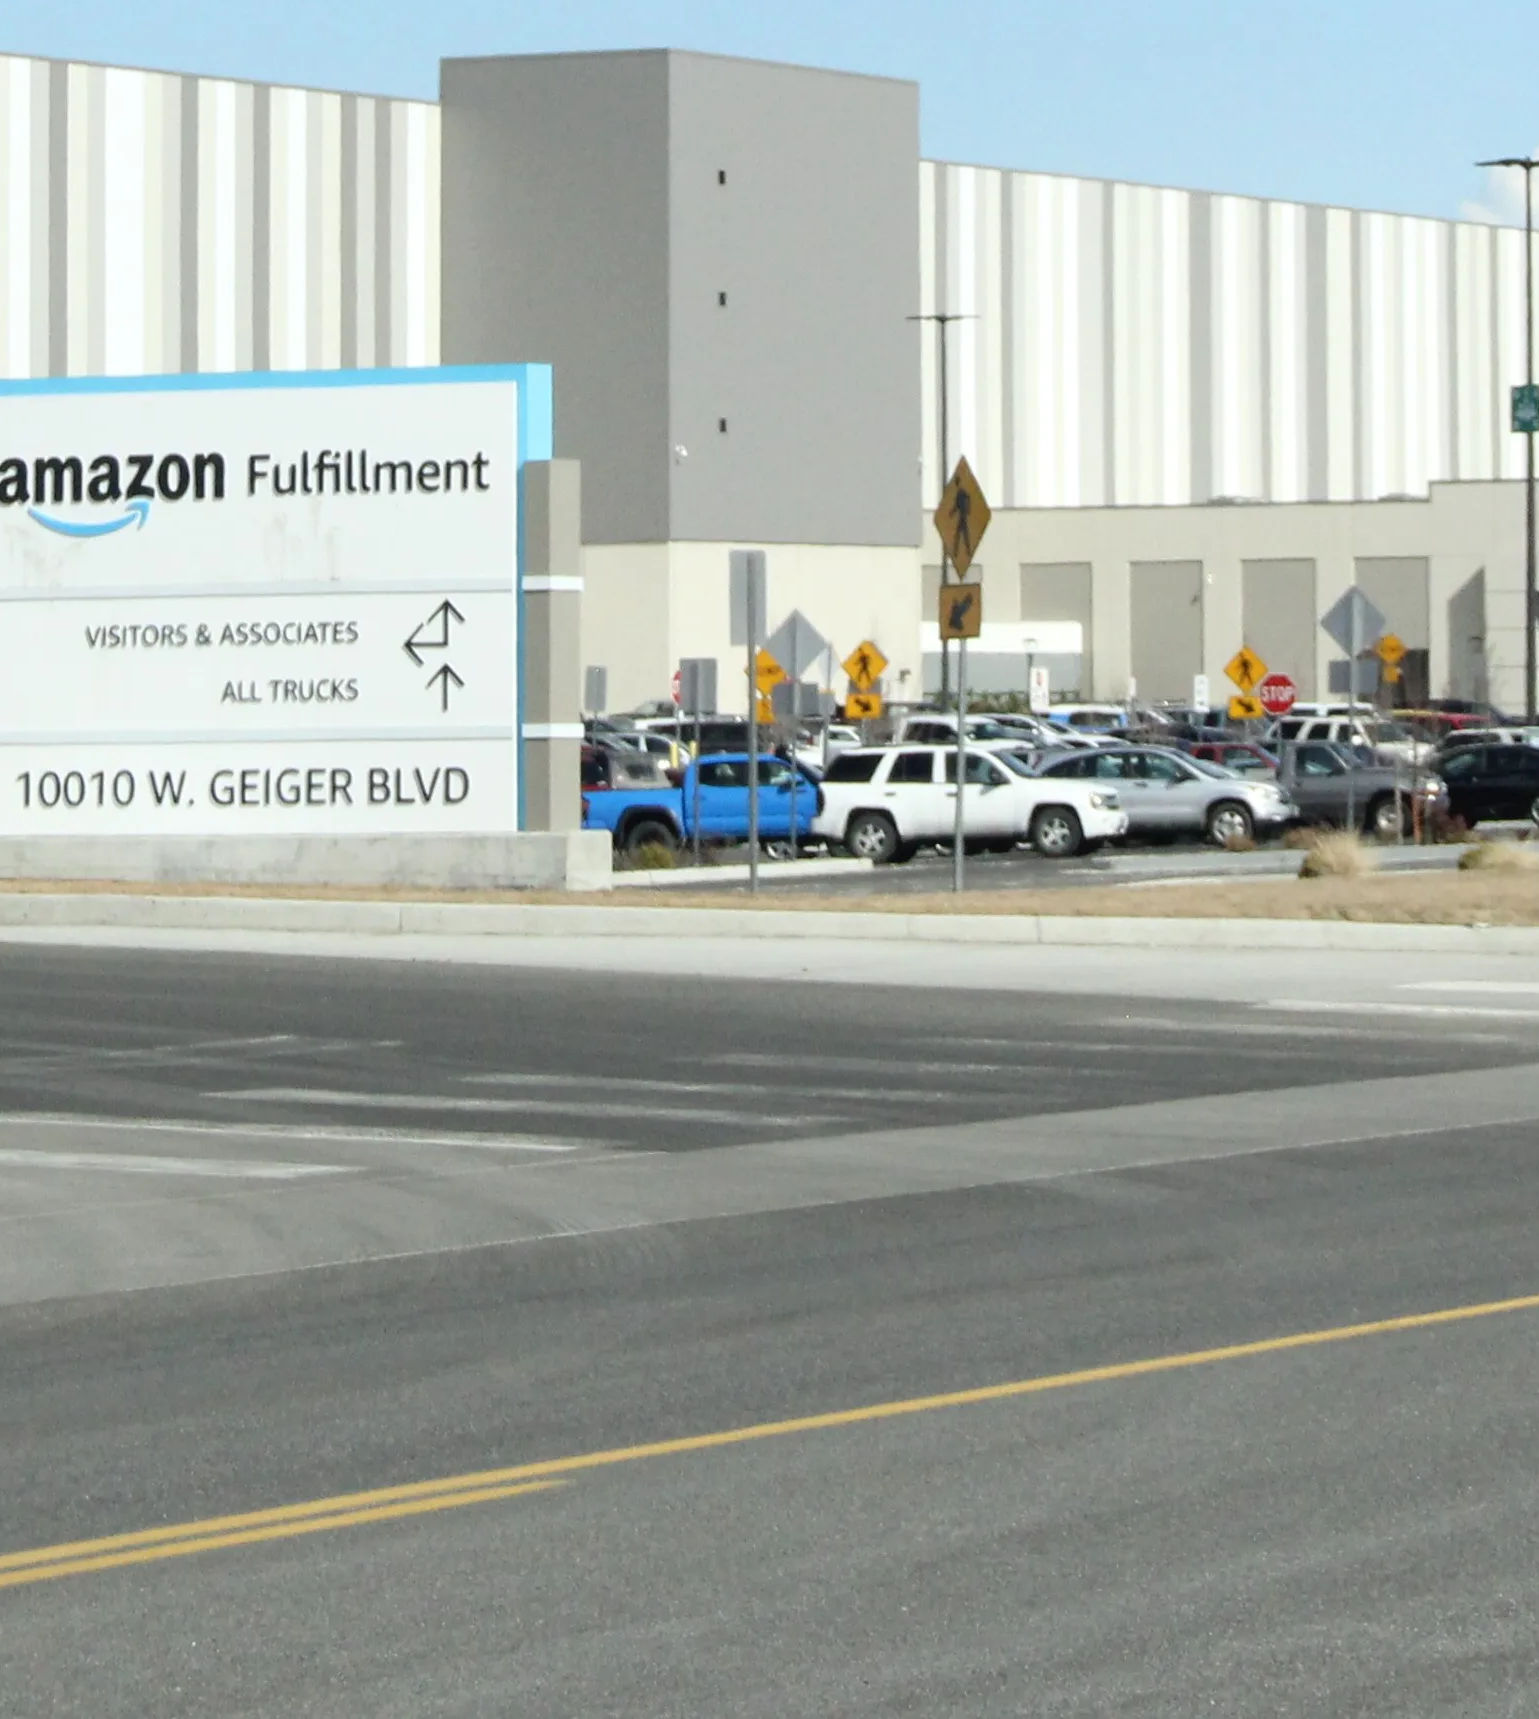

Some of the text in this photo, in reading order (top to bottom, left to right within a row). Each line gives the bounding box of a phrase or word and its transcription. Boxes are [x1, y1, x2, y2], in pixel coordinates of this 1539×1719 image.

[247, 449, 491, 497] Fulfillment
[85, 620, 360, 649] VISITORS & ASSOCIATES
[220, 678, 360, 704] ALL TRUCKS
[1261, 685, 1296, 703] STOP
[16, 766, 471, 809] 10010 W. GEIGER BLVD
